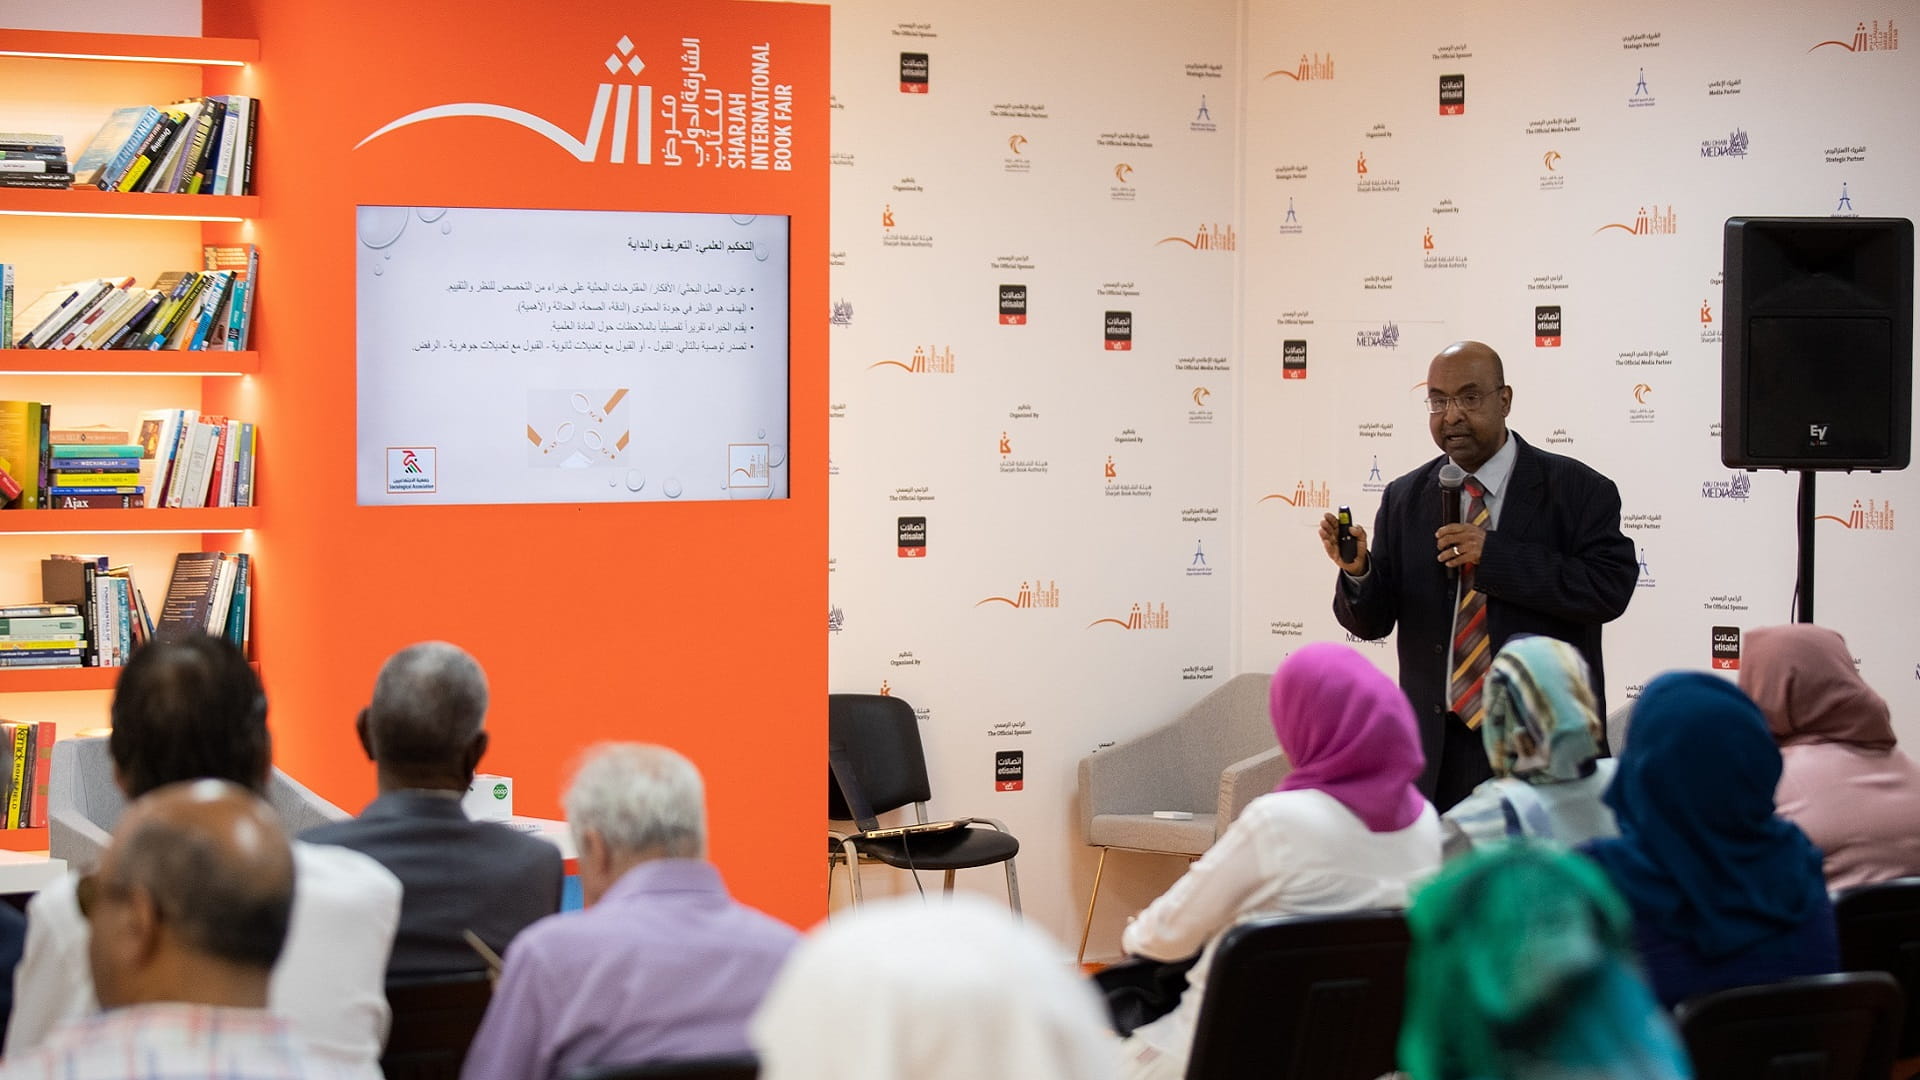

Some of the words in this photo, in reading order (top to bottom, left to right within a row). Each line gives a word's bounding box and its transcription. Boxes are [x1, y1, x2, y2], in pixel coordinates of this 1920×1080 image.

[680, 38, 706, 101] الشارقة
[751, 42, 770, 170] INTERNATIONAL
[774, 84, 792, 120] FAIR
[704, 89, 727, 168] للكتاب
[728, 93, 746, 168] SHARJAH
[149, 126, 172, 153] Drawing
[681, 103, 710, 167] الدولي
[774, 125, 792, 171] BOOK
[1700, 146, 1729, 158] MEDIA
[628, 238, 658, 251] والبداية
[661, 240, 692, 252] التعريف
[727, 241, 754, 252] التحكيم
[704, 286, 722, 294] العمل
[697, 304, 712, 313] النظر
[715, 306, 724, 314] هو
[727, 304, 746, 314] الهدف
[598, 322, 613, 332] حول
[1537, 322, 1560, 331] etisalat
[523, 340, 543, 352] القبول
[616, 341, 635, 352] القبول
[654, 341, 673, 352] القبول
[1356, 337, 1381, 347] MEDIA
[1701, 487, 1730, 498] MEDIA
[64, 496, 89, 510] Ajax
[1714, 633, 1738, 642] اتصالات
[1714, 643, 1738, 652] etisalat
[998, 757, 1022, 766] اتصالات
[998, 767, 1022, 775] etisalat
